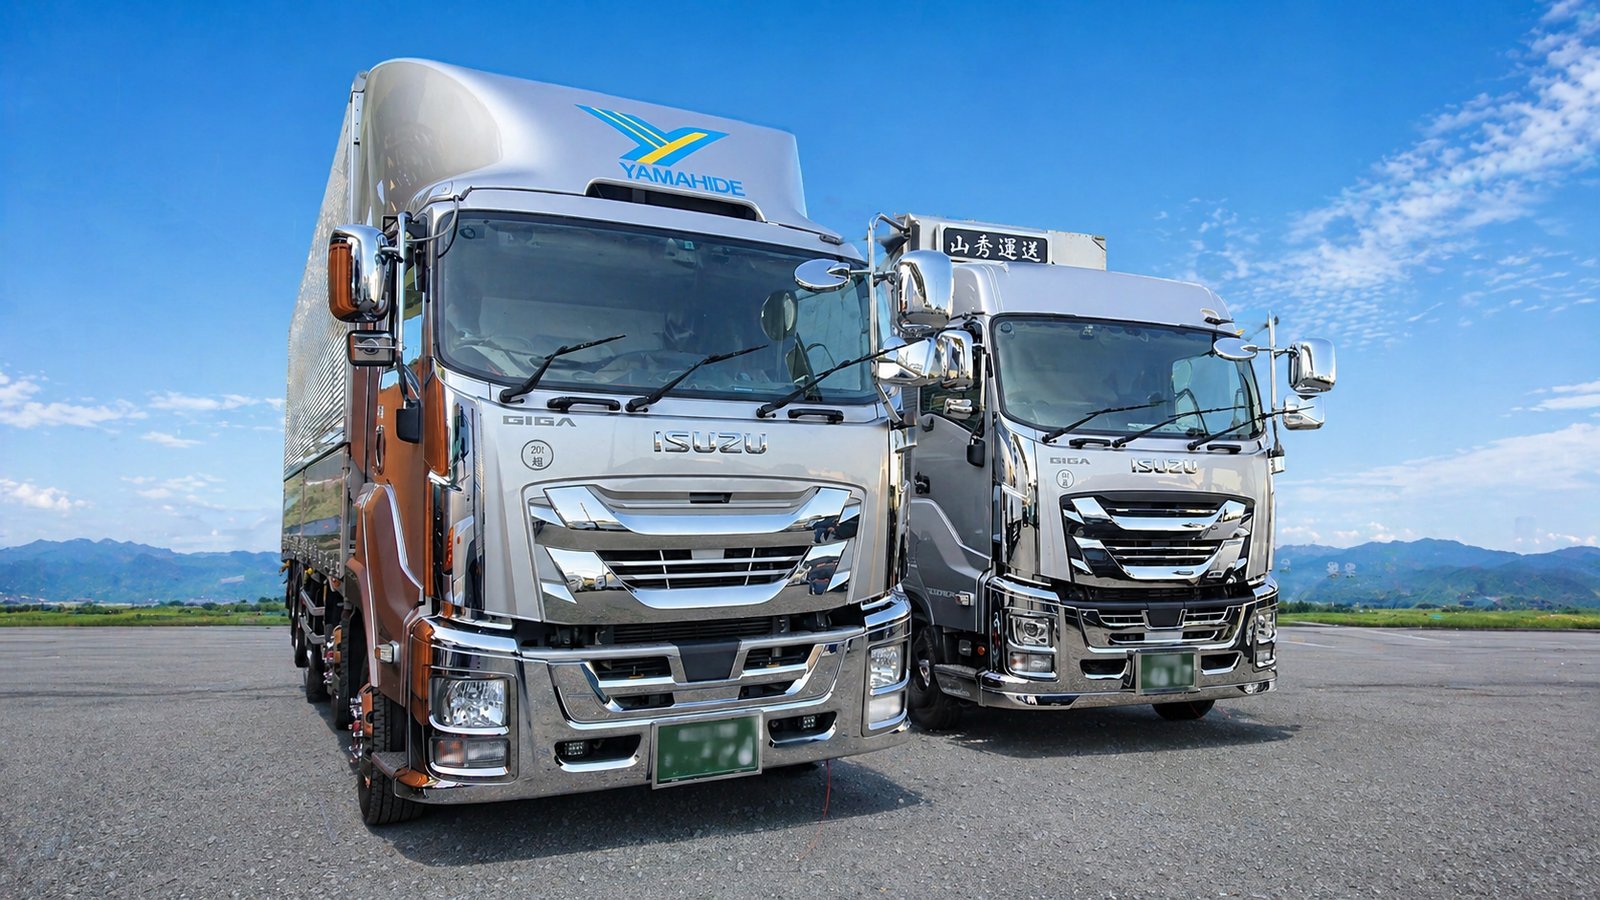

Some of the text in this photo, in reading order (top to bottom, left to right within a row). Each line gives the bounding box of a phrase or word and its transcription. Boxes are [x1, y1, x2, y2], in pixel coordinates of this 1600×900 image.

[619, 162, 746, 197] YAMAHIDE
[950, 234, 1041, 262] 山秀運送
[502, 415, 577, 428] GIGA
[653, 430, 768, 455] ISUZU
[1049, 457, 1091, 465] GIGA
[1131, 457, 1198, 475] ISUZU
